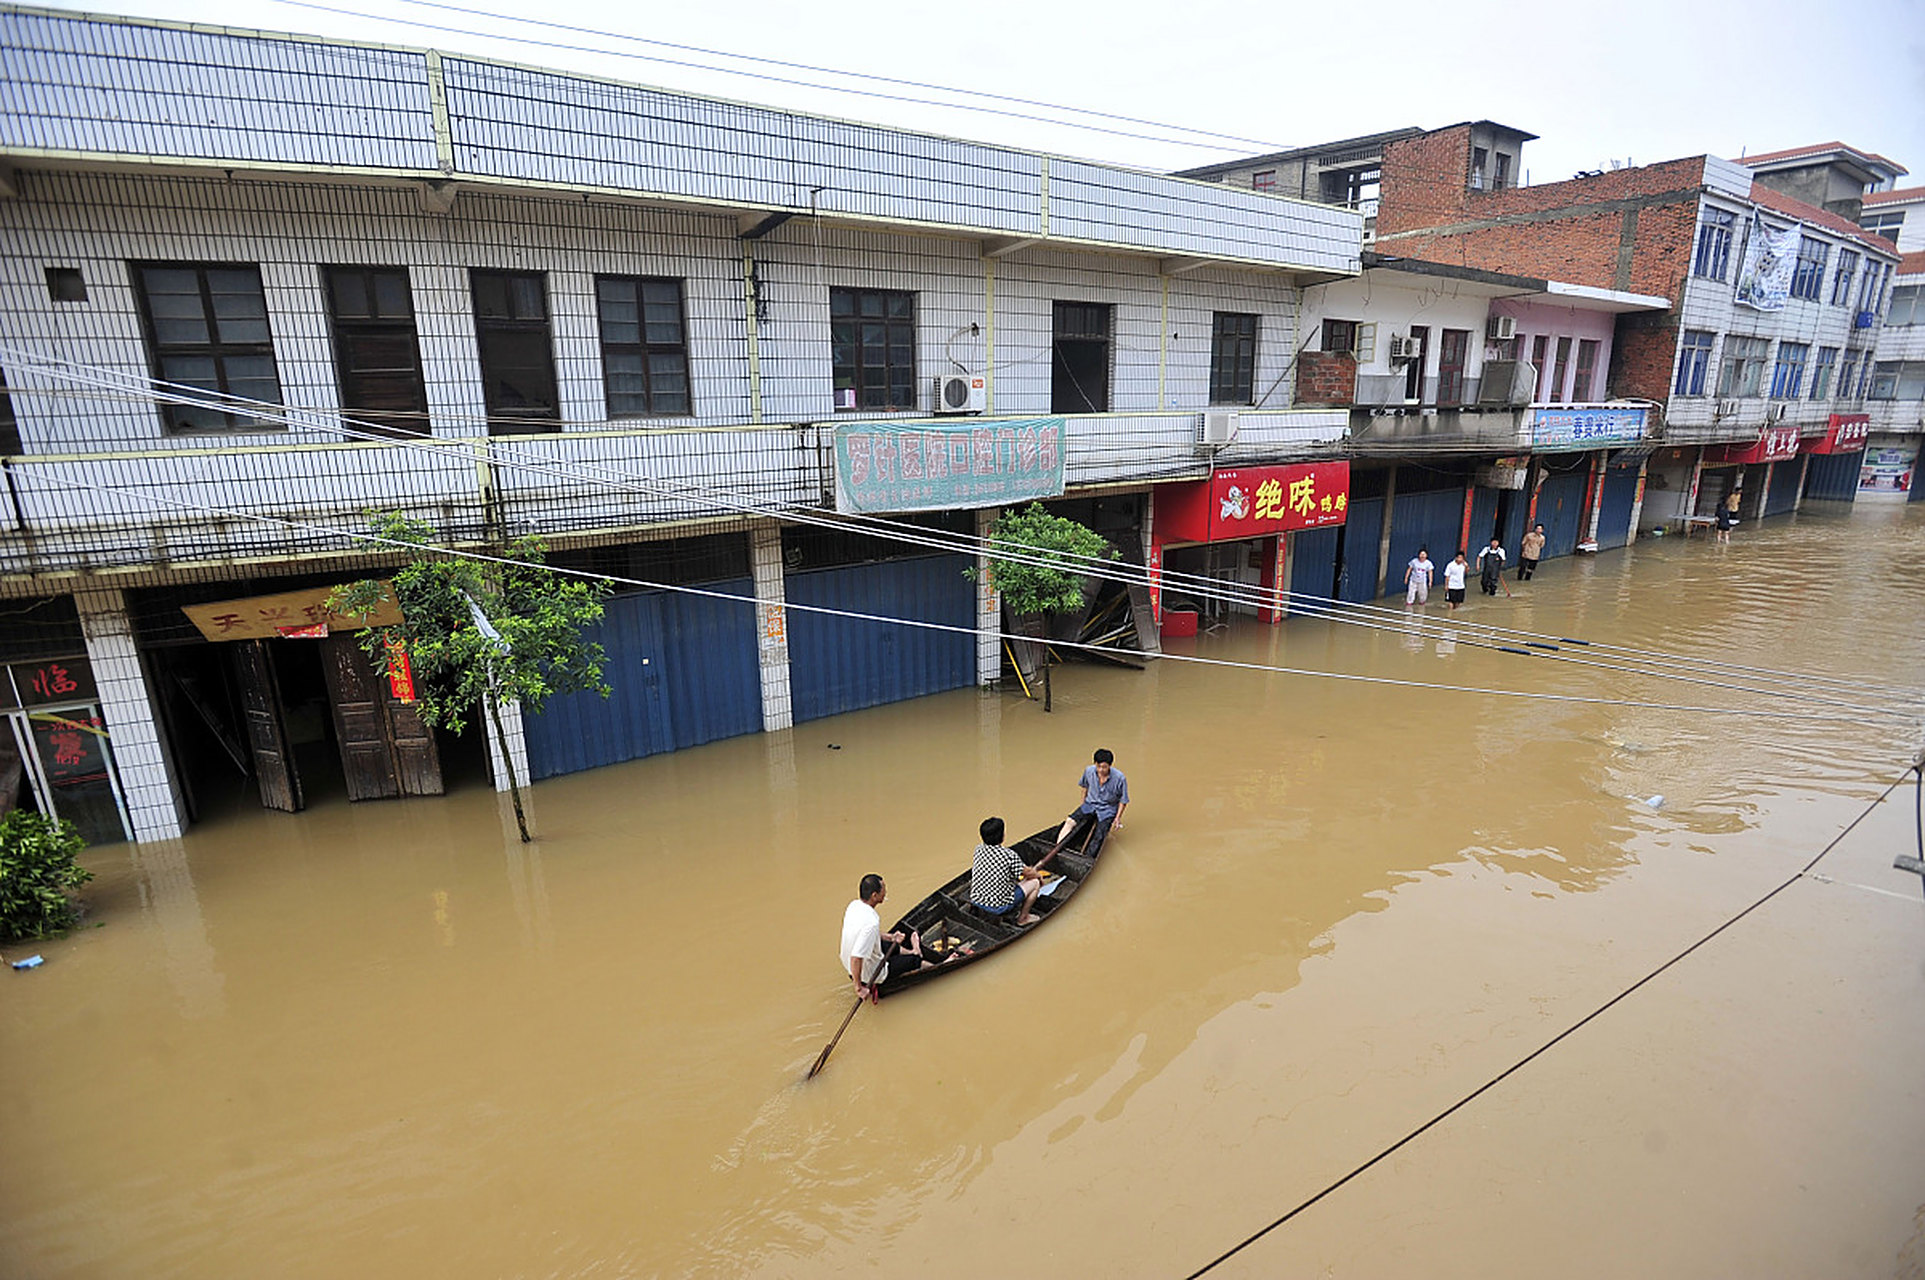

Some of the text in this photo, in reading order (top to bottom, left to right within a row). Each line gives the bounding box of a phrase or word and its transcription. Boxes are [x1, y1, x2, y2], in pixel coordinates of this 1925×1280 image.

[847, 426, 1058, 485] 罗针医院口腔门诊部
